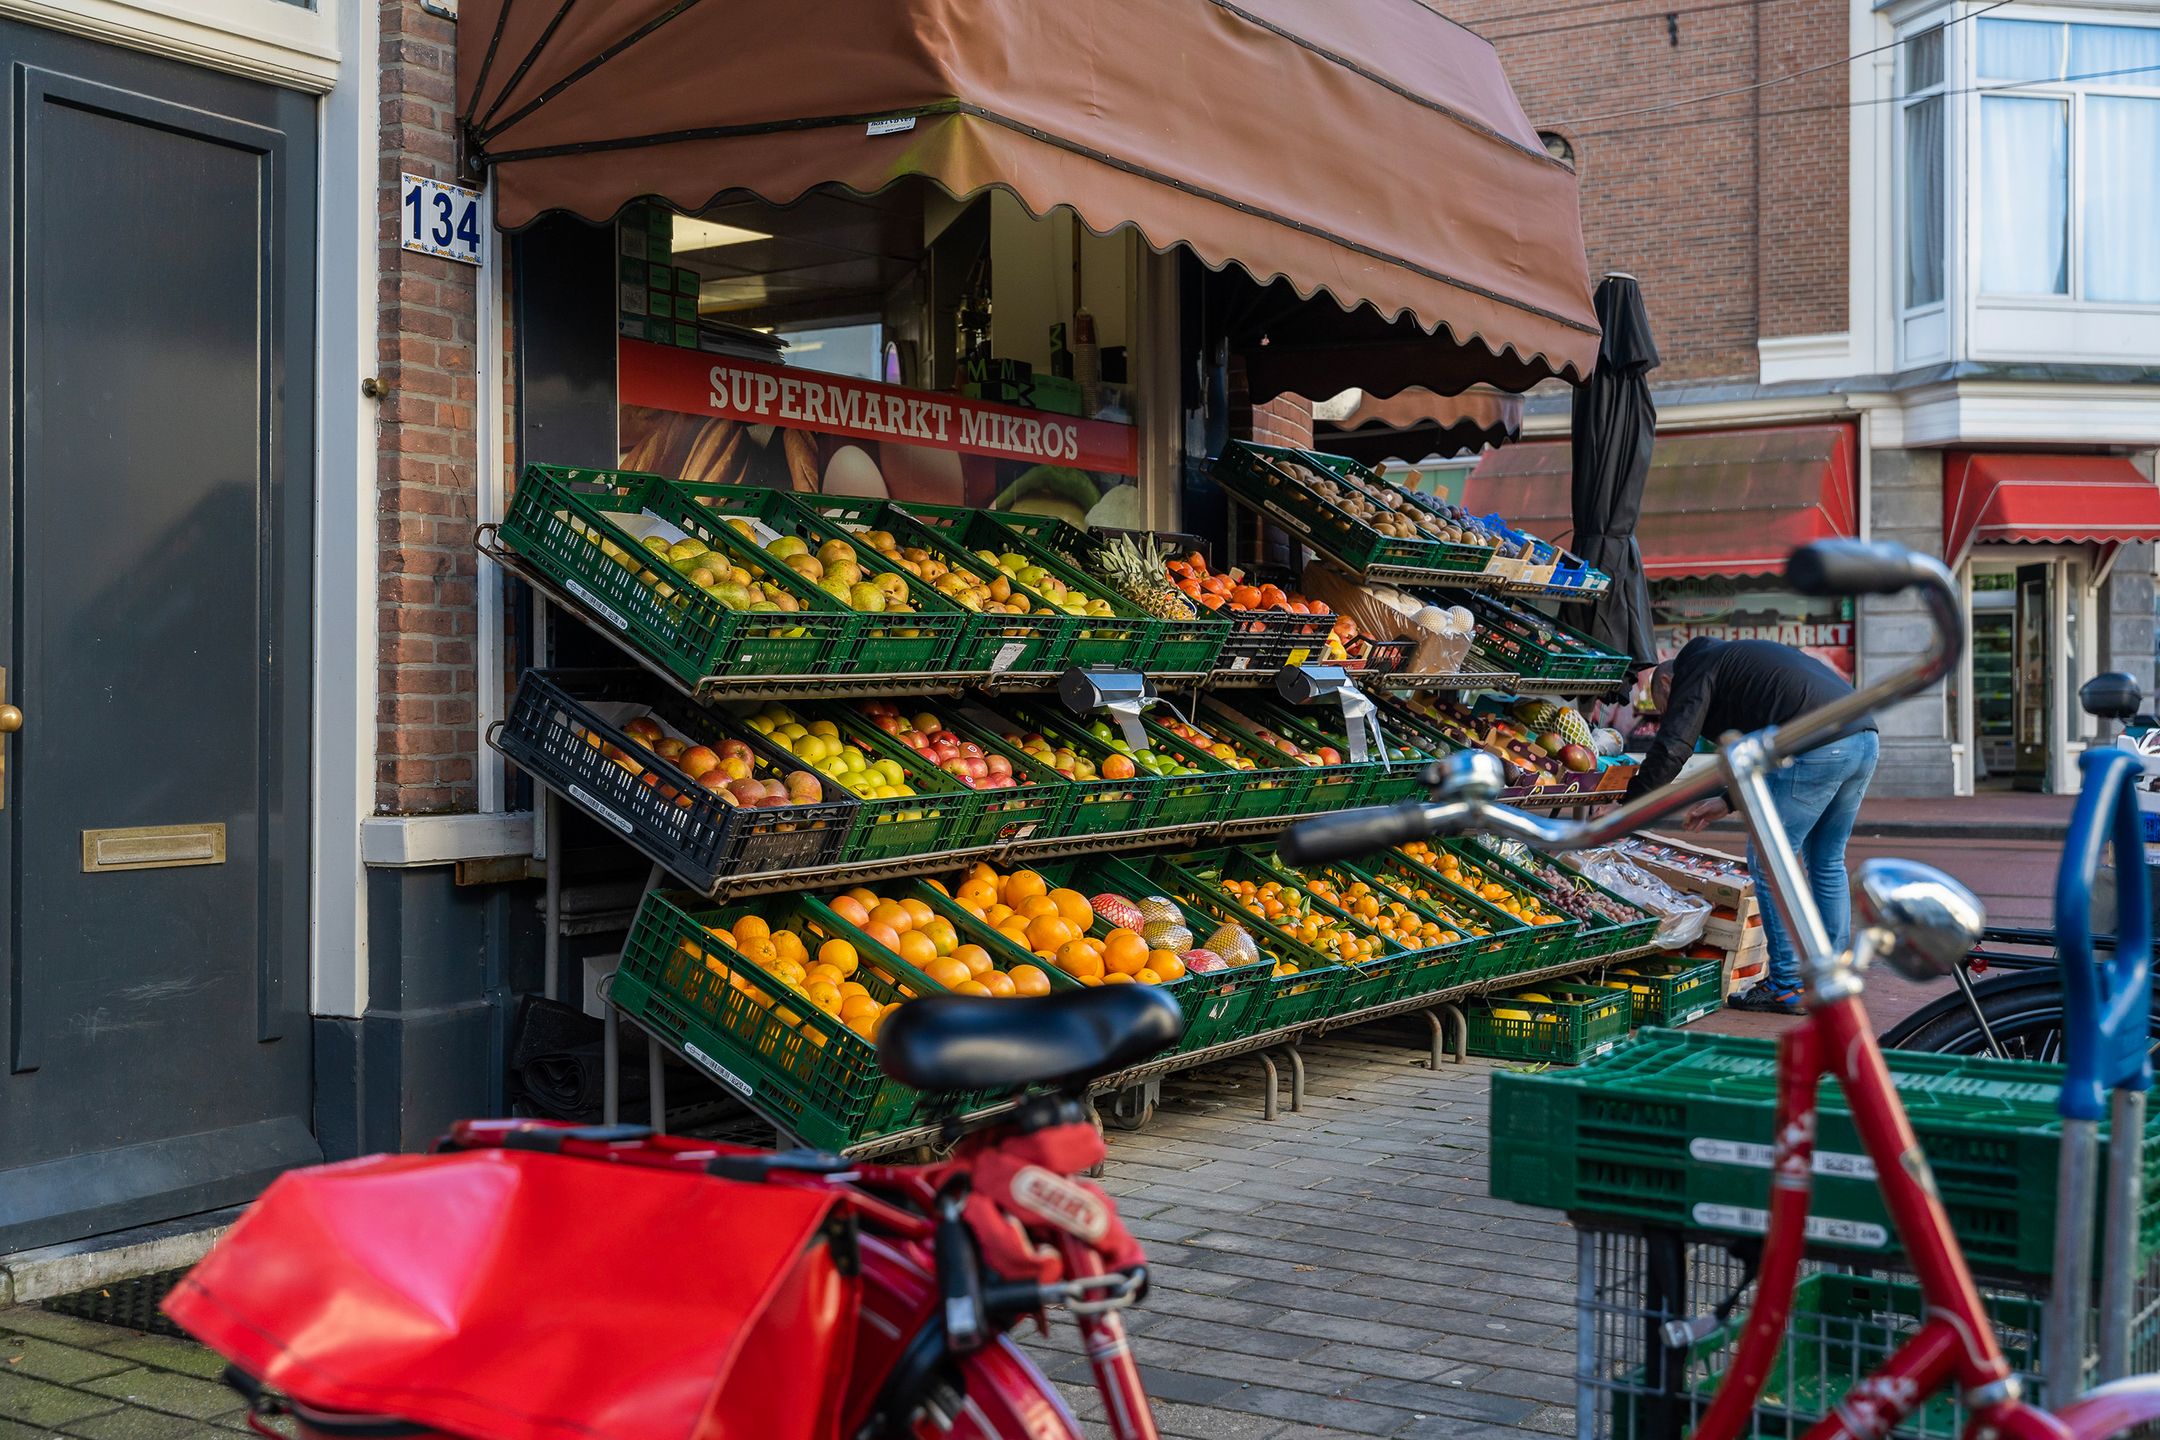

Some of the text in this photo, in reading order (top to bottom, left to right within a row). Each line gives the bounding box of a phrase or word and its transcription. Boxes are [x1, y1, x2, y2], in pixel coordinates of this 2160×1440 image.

[406, 185, 480, 253] 134
[710, 366, 951, 441] SUPERMARKT
[959, 408, 1078, 461] MIKROS
